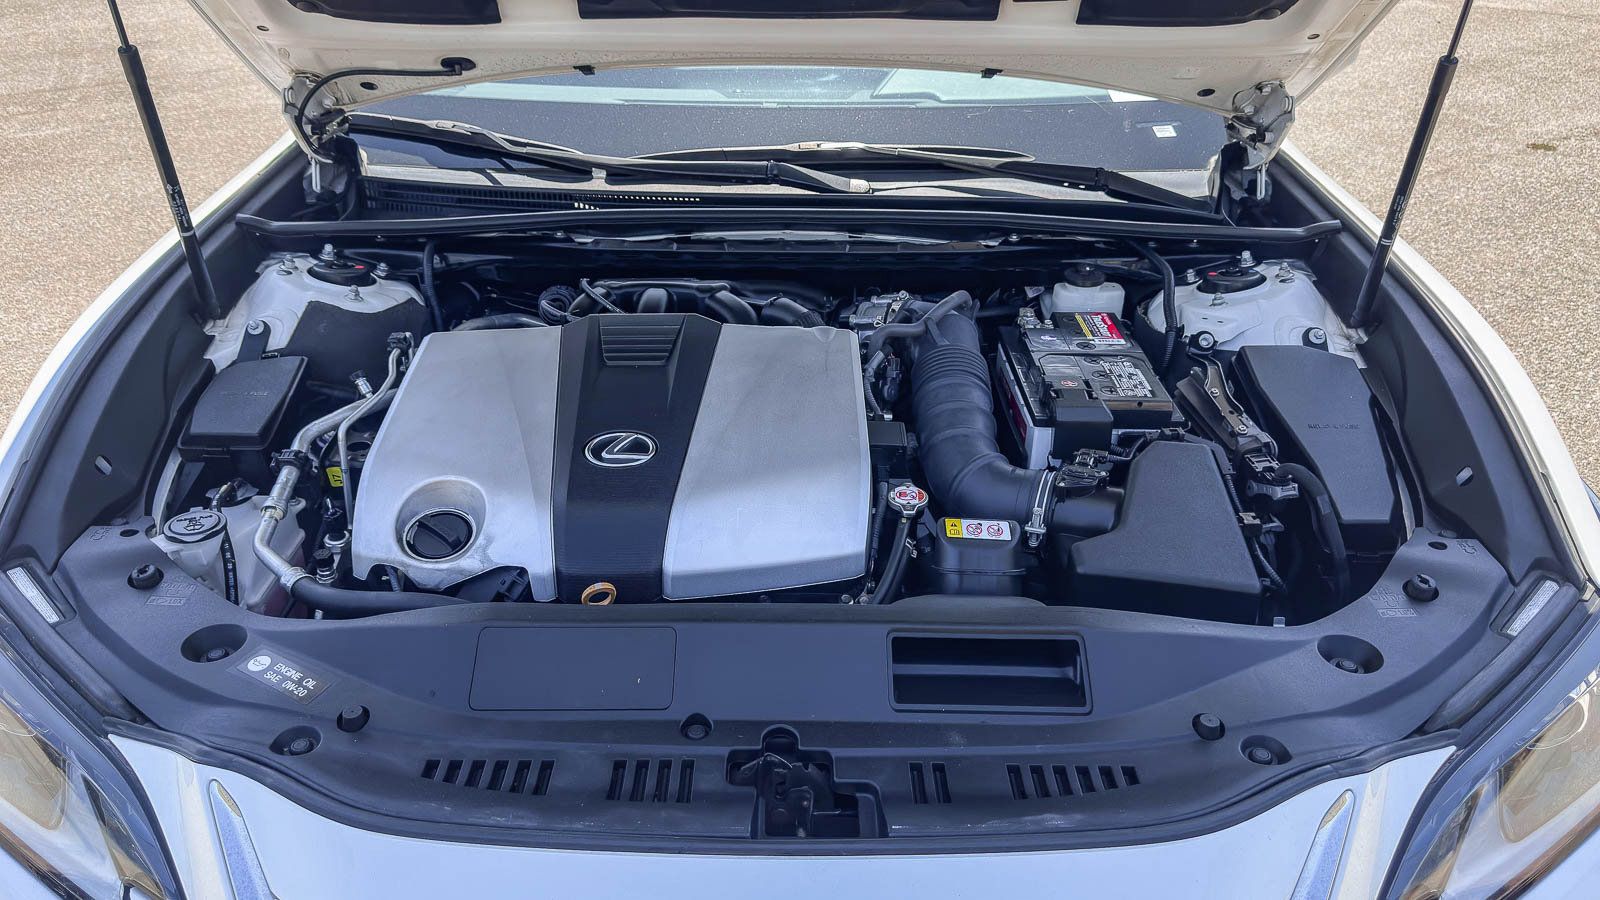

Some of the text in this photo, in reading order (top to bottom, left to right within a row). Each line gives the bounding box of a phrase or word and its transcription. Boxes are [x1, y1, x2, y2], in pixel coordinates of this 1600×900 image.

[263, 671, 308, 697] SAE 0W-20
[273, 663, 317, 690] ENGINE OIL
